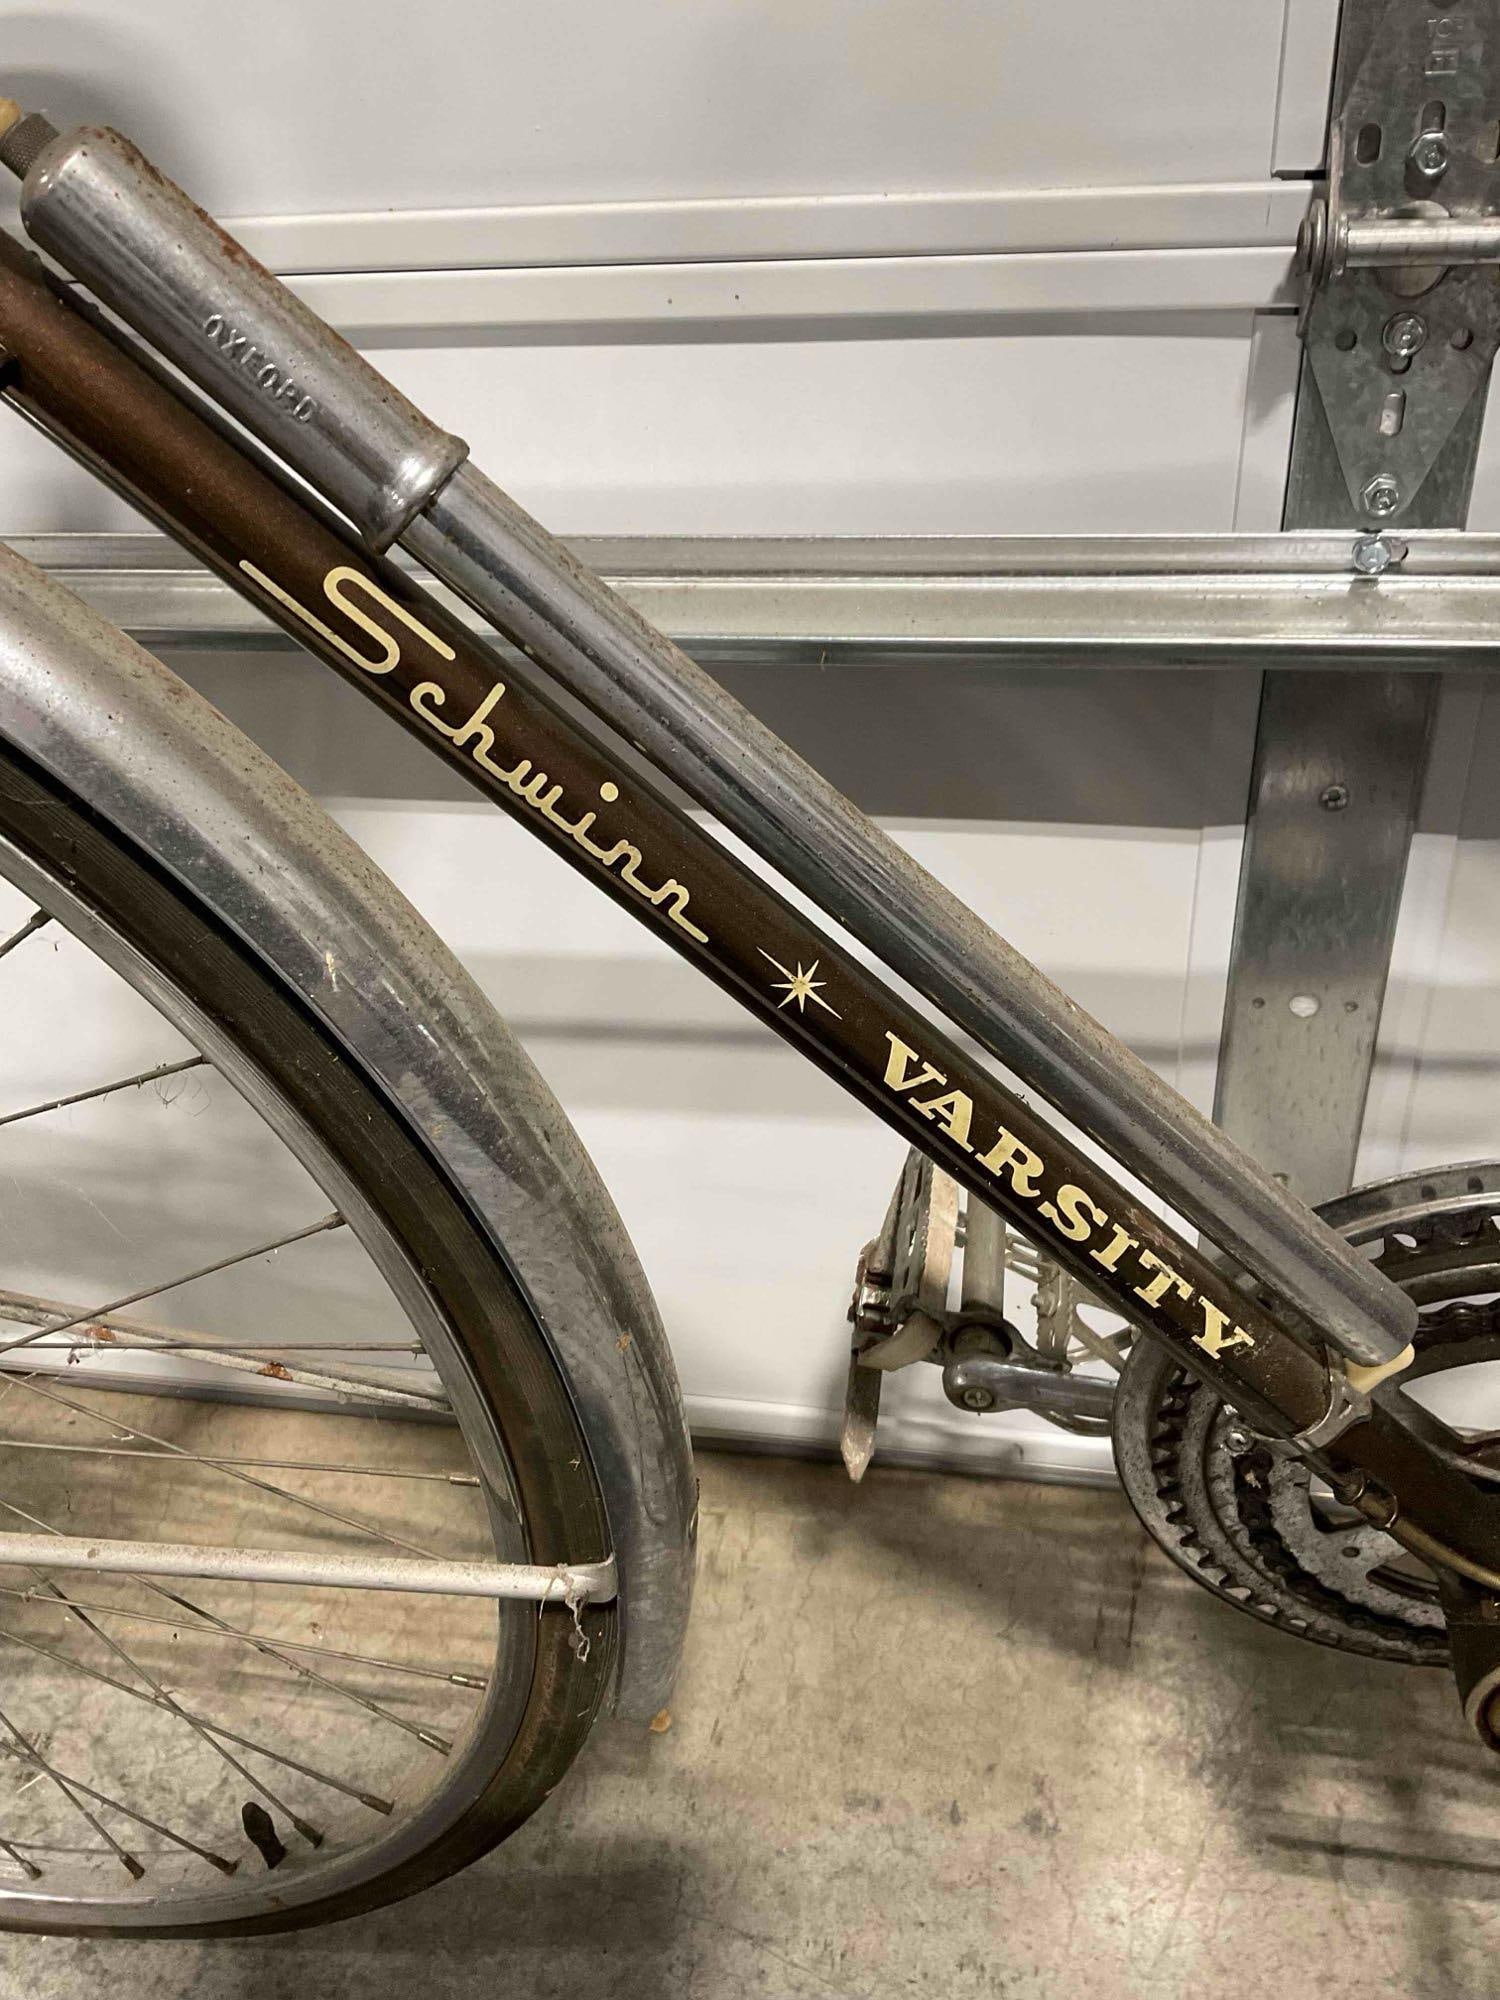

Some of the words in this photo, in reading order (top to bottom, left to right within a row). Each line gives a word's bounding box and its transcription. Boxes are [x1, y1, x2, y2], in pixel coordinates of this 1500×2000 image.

[203, 314, 319, 423] OXFORD
[239, 560, 709, 943] Schwinn
[883, 1030, 1255, 1360] VARSITY
